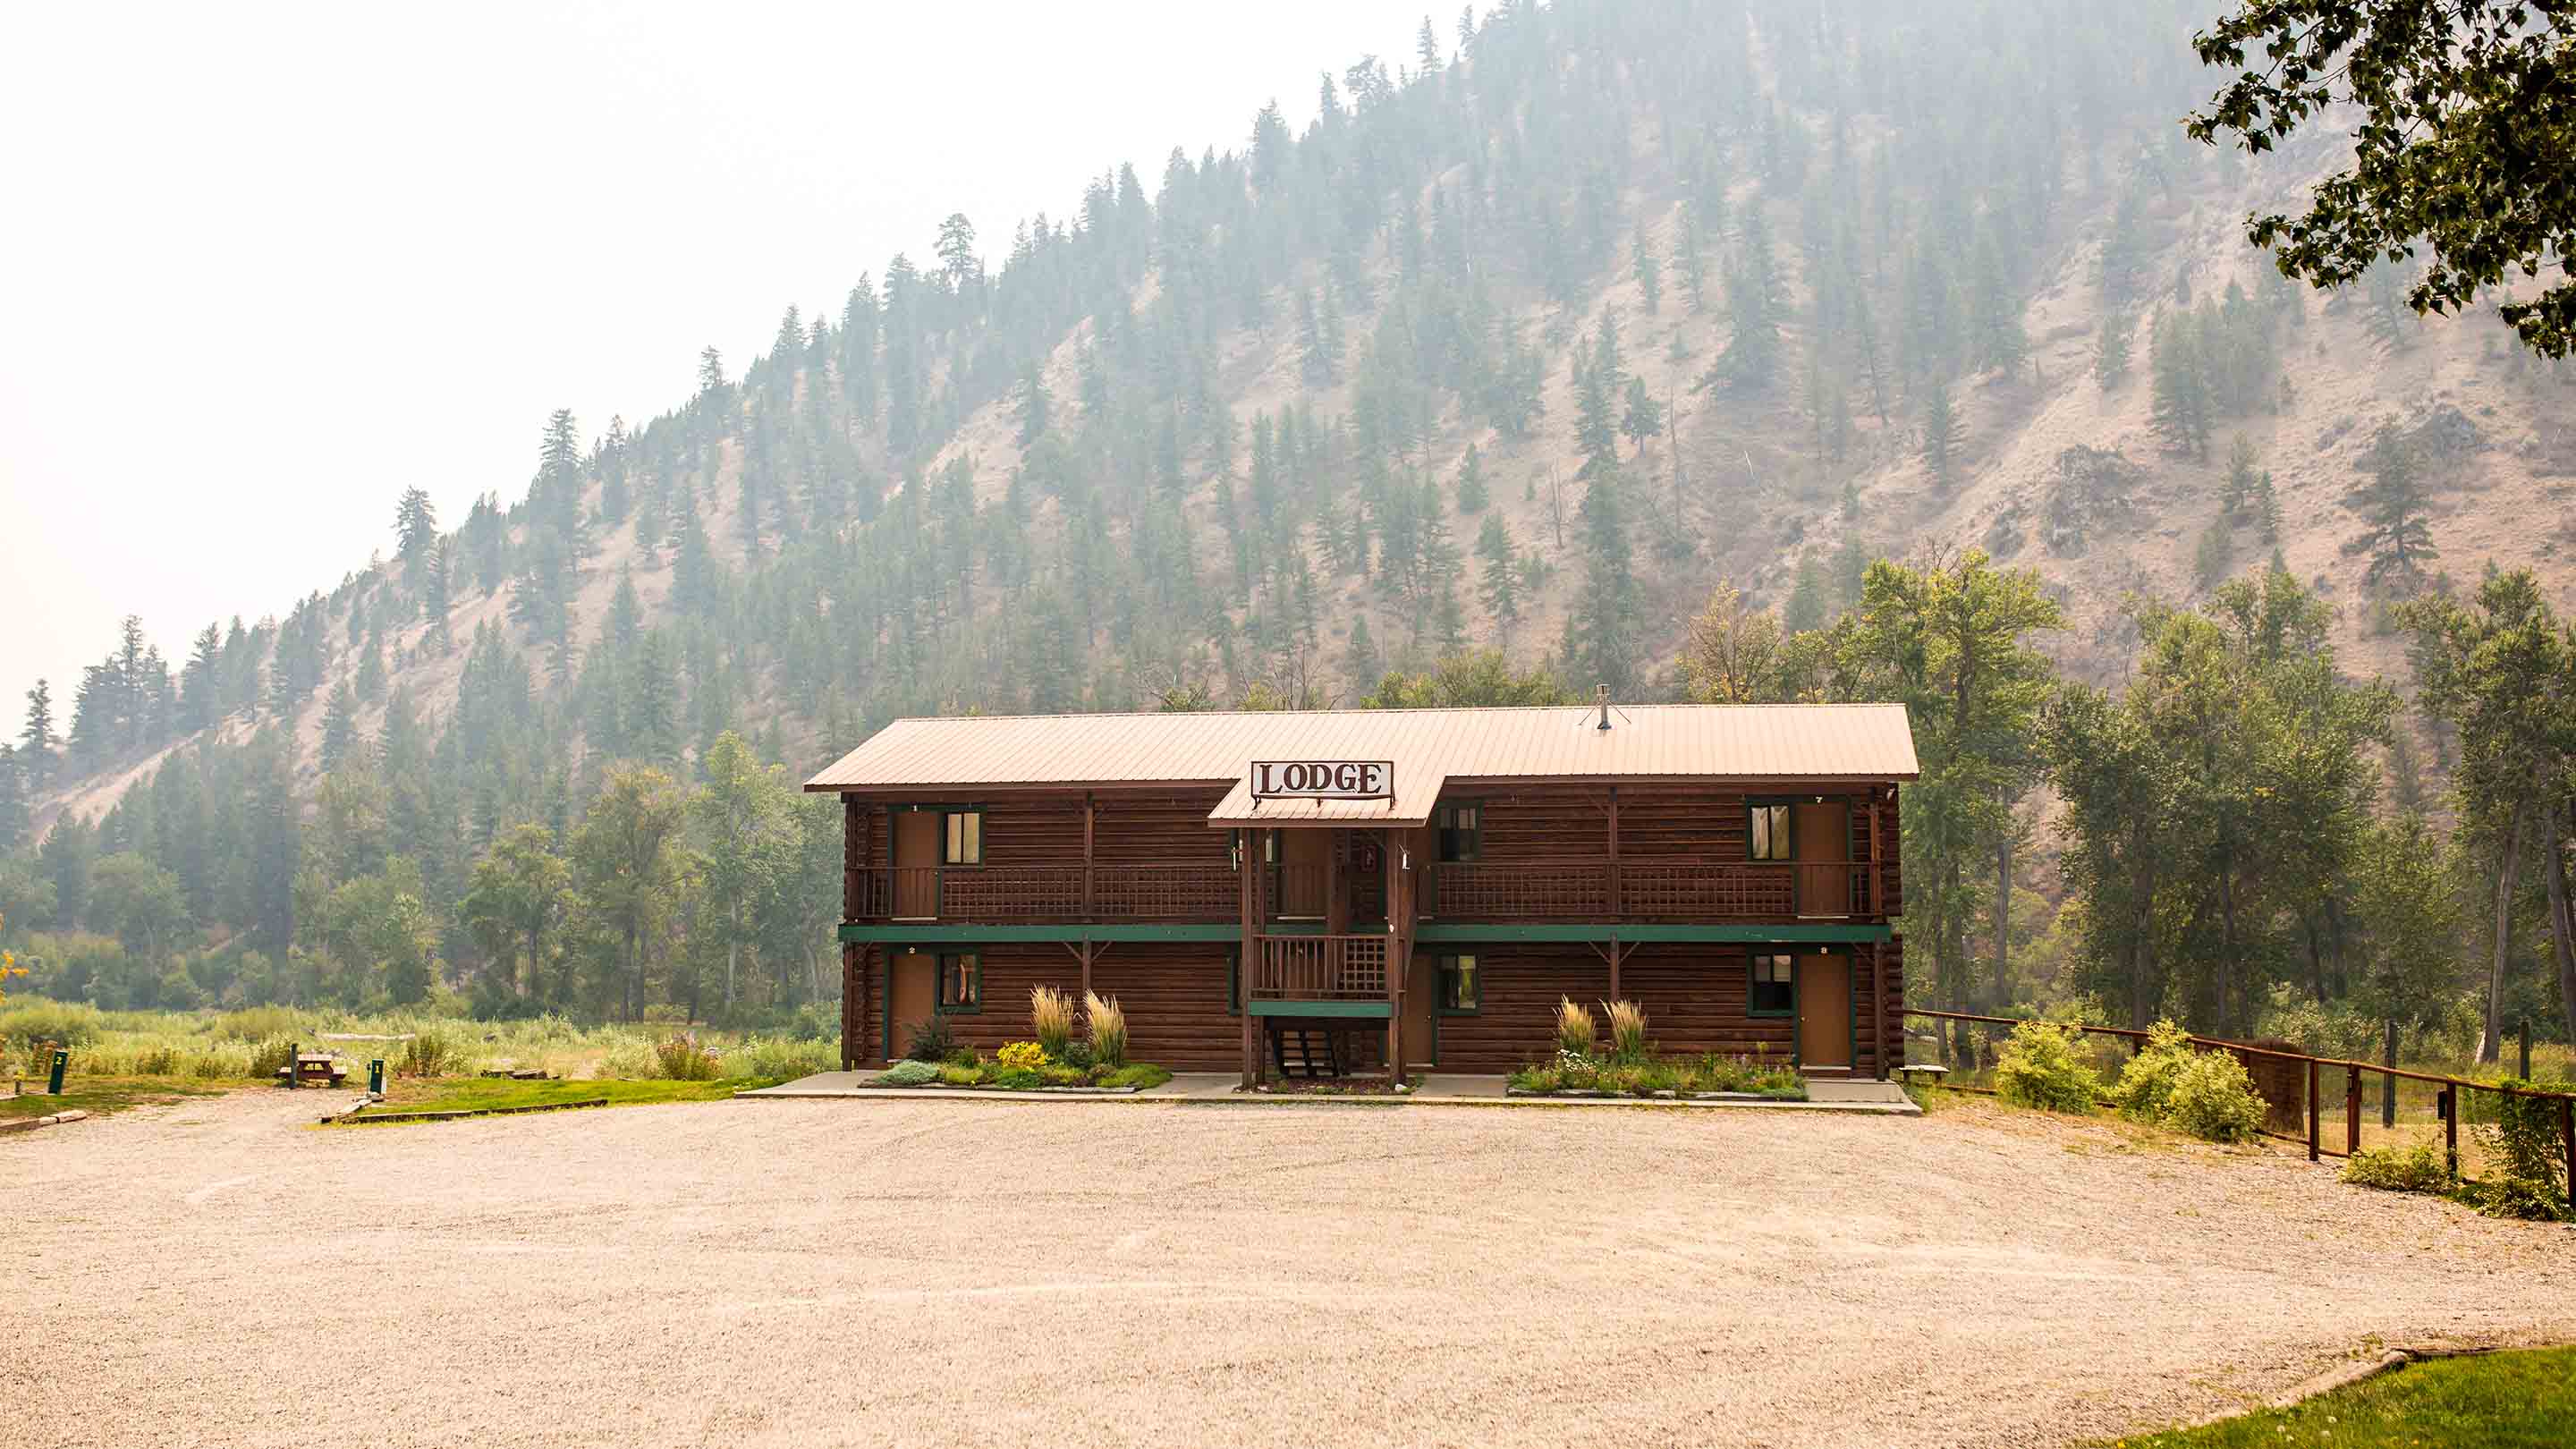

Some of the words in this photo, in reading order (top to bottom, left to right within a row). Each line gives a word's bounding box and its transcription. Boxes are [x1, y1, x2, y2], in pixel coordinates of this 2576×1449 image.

[1258, 764, 1382, 793] LODGE
[55, 1055, 63, 1065] 2
[375, 1064, 380, 1073] 1
